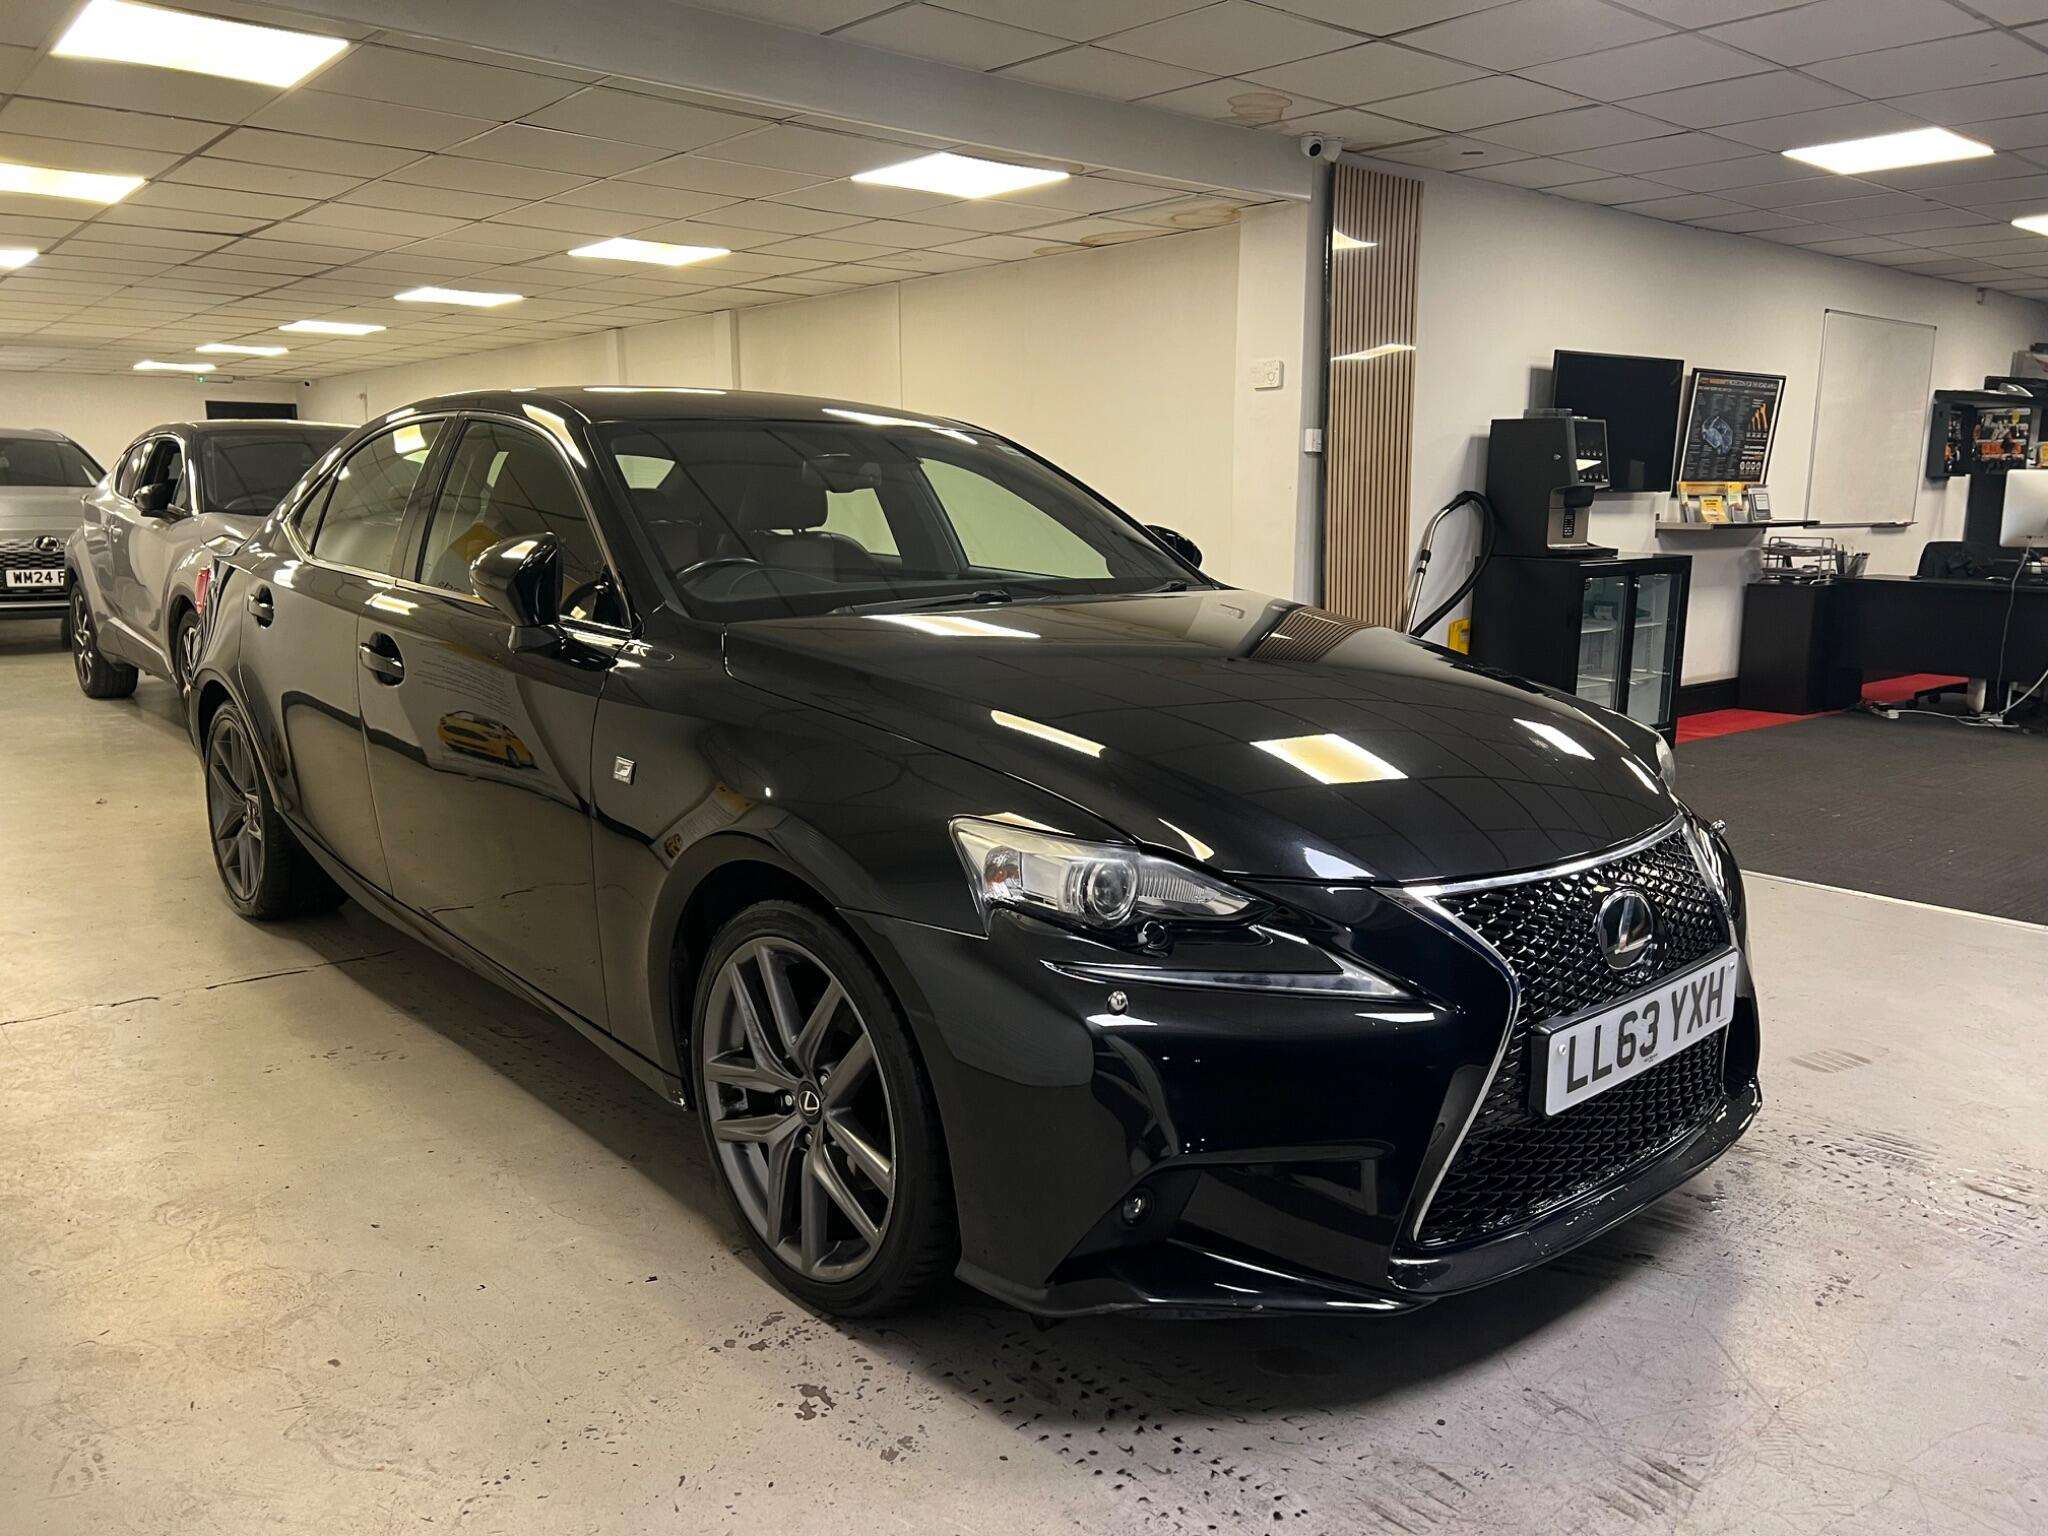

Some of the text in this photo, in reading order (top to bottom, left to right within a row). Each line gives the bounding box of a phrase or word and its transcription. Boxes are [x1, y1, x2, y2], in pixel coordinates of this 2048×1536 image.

[13, 571, 53, 584] WM24
[1566, 966, 1726, 1094] LL63 YXH
